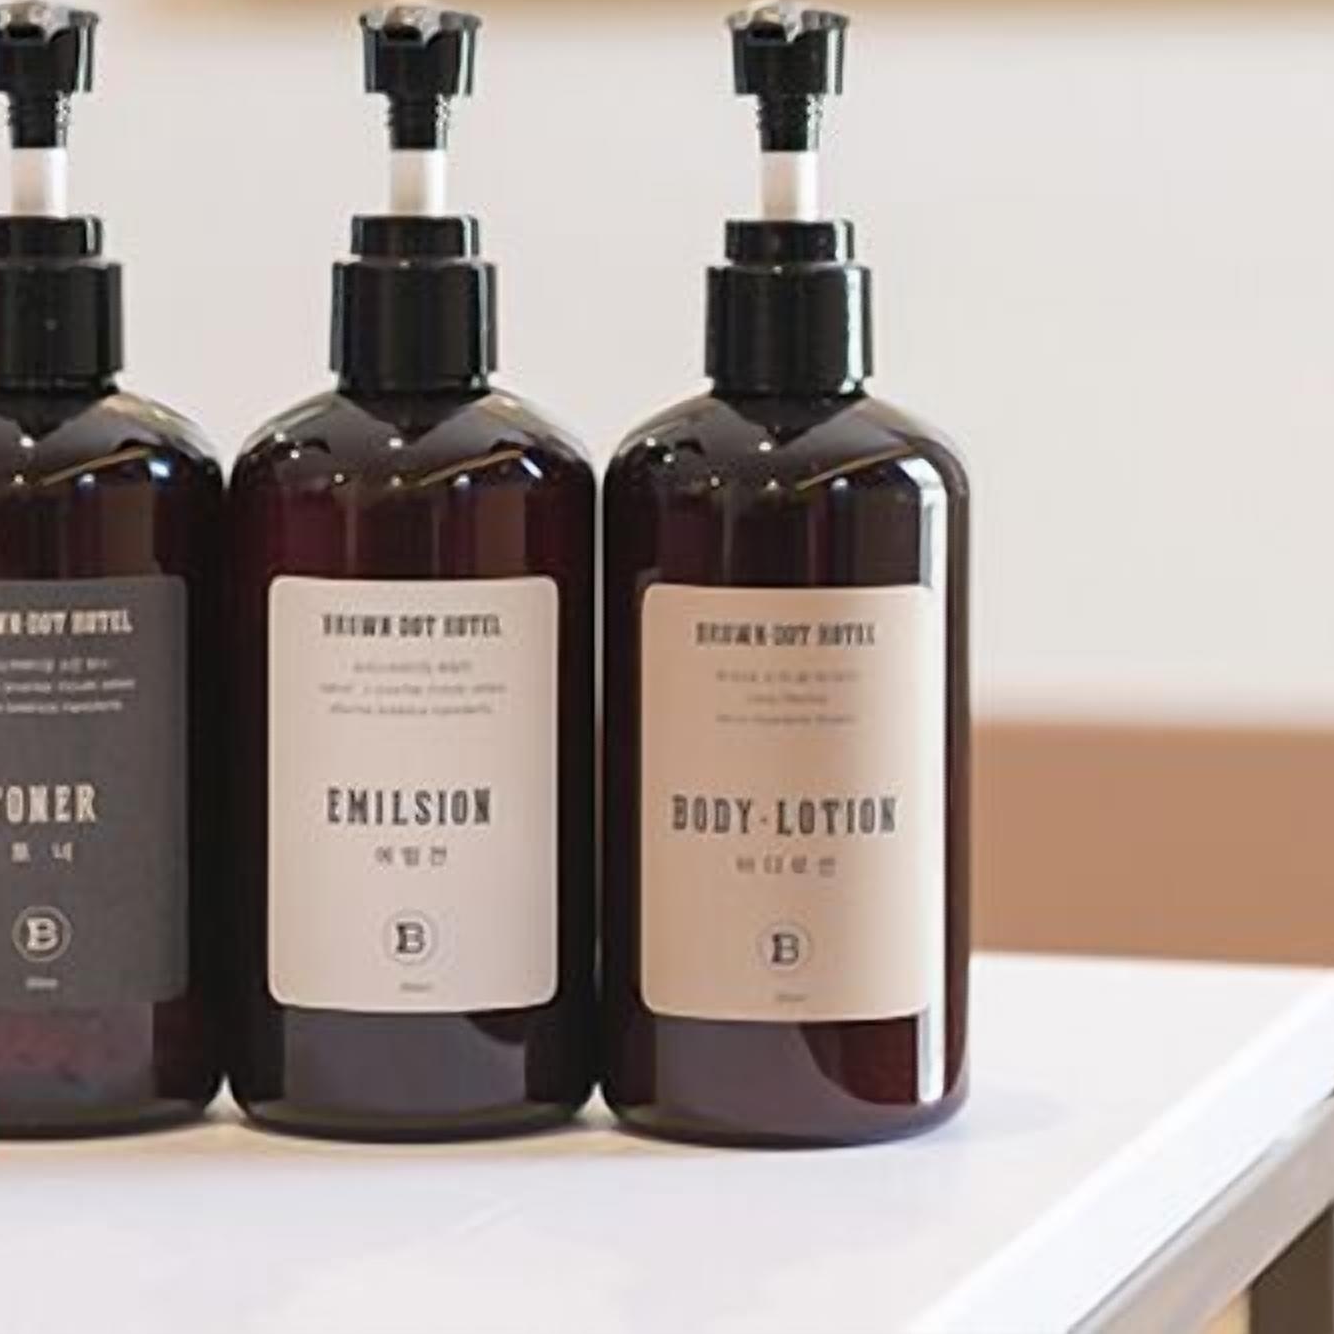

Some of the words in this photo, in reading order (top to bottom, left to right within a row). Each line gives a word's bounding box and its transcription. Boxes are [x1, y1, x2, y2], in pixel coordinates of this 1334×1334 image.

[327, 787, 491, 826] EMILSION
[27, 917, 58, 951] B
[396, 922, 426, 954] B
[771, 933, 800, 966] B
